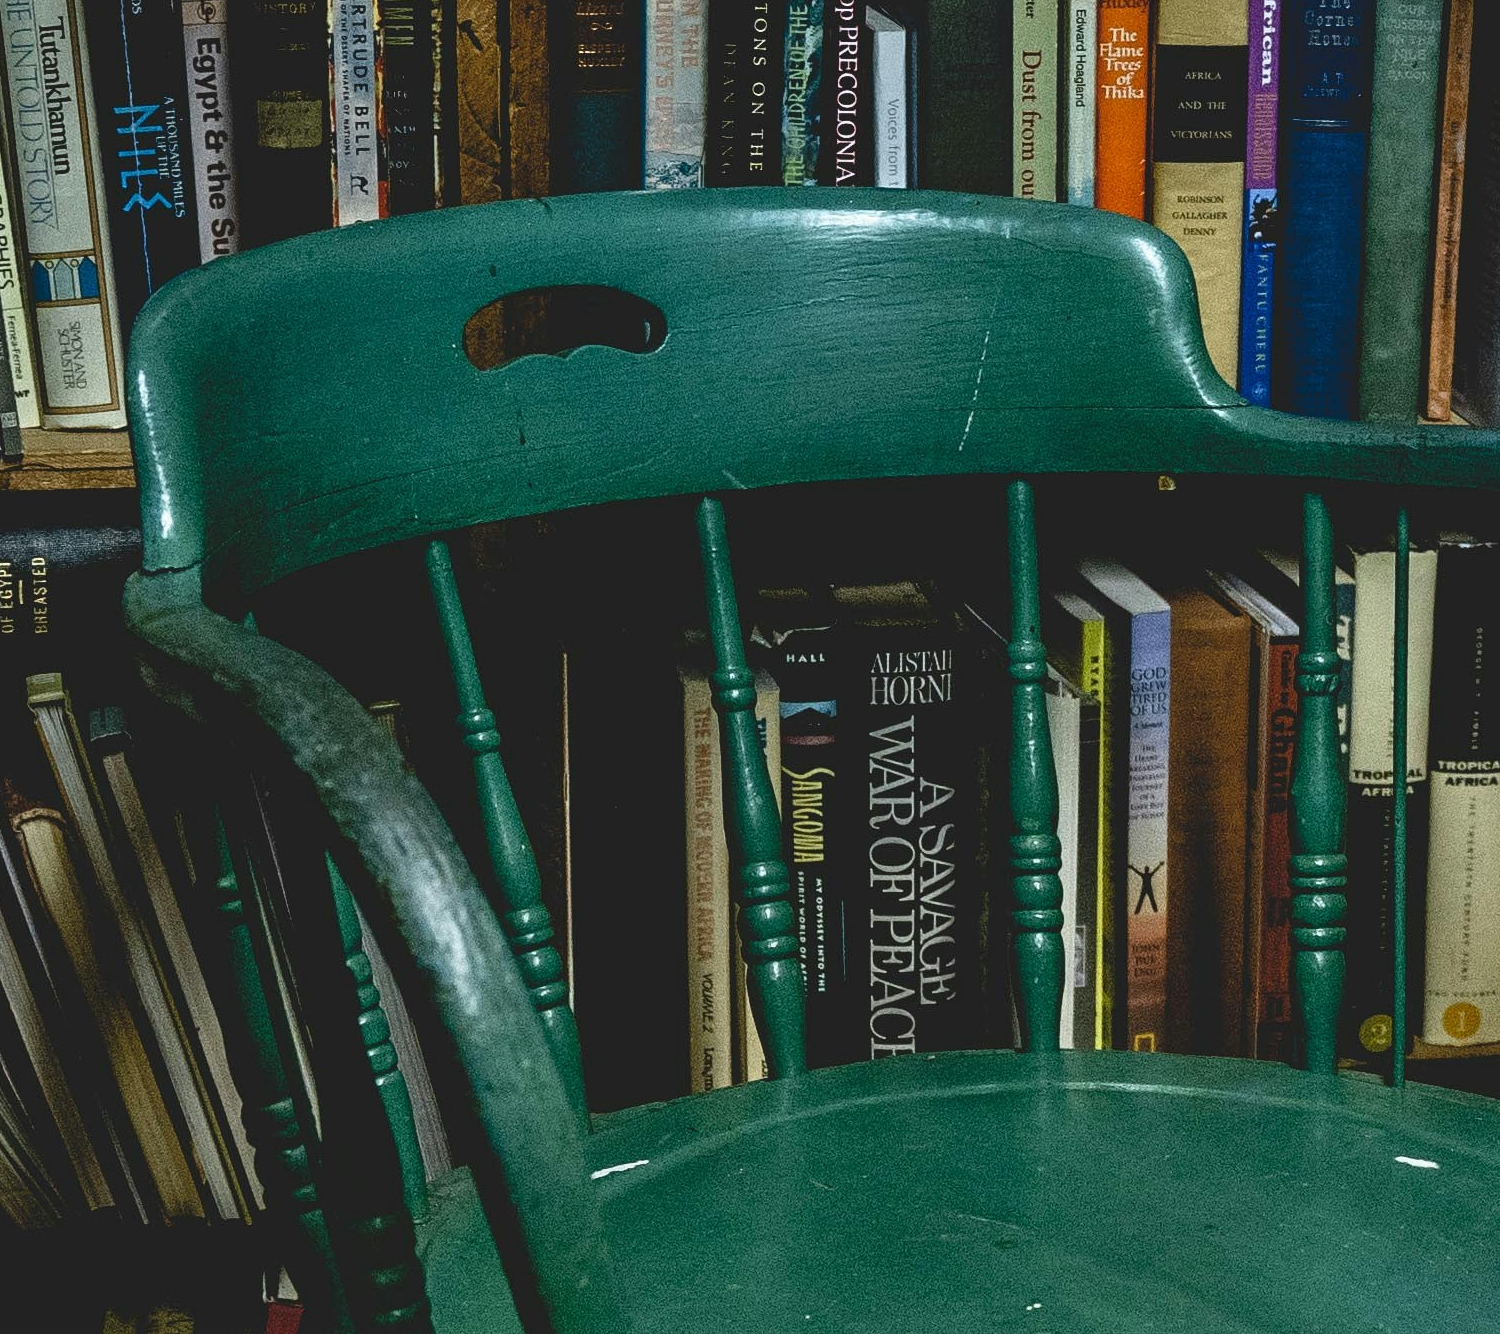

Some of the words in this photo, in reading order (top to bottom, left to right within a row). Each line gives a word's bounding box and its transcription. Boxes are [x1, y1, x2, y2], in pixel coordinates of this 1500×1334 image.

[192, 35, 223, 125] Egypt
[1109, 27, 1138, 43] The
[39, 16, 71, 177] Tutankhamun
[353, 106, 371, 157] BELL
[869, 715, 916, 830] WAR
[869, 836, 916, 902] OF
[920, 823, 956, 1005] SAVAGE
